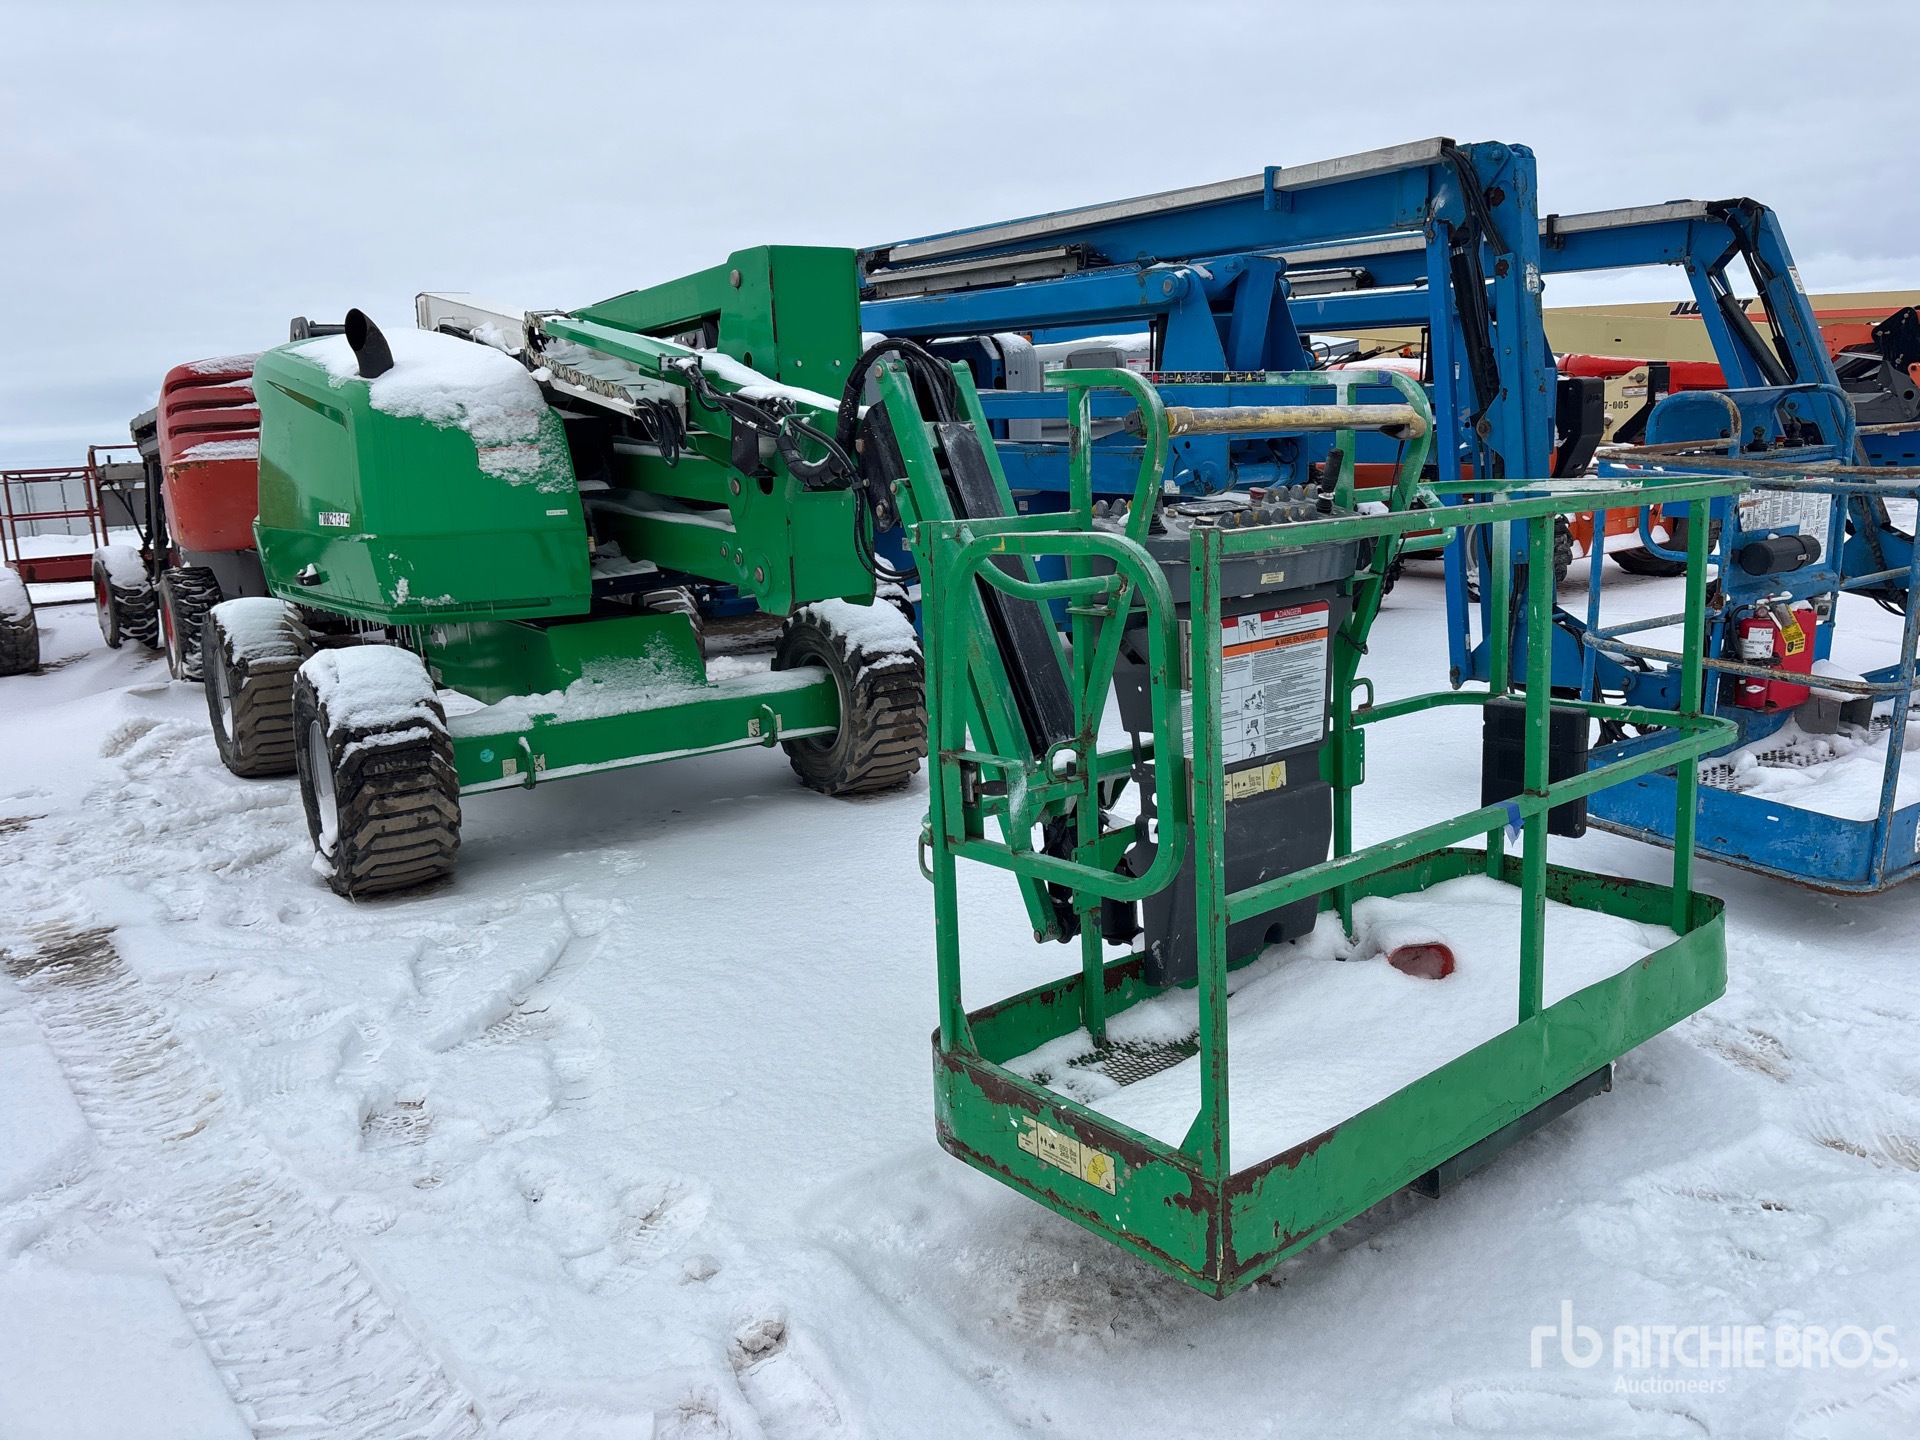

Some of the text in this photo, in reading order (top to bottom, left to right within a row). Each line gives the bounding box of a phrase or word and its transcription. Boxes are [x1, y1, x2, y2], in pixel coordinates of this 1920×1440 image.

[1279, 607, 1302, 618] DANGER
[1280, 631, 1317, 645] MISE EN GARDE
